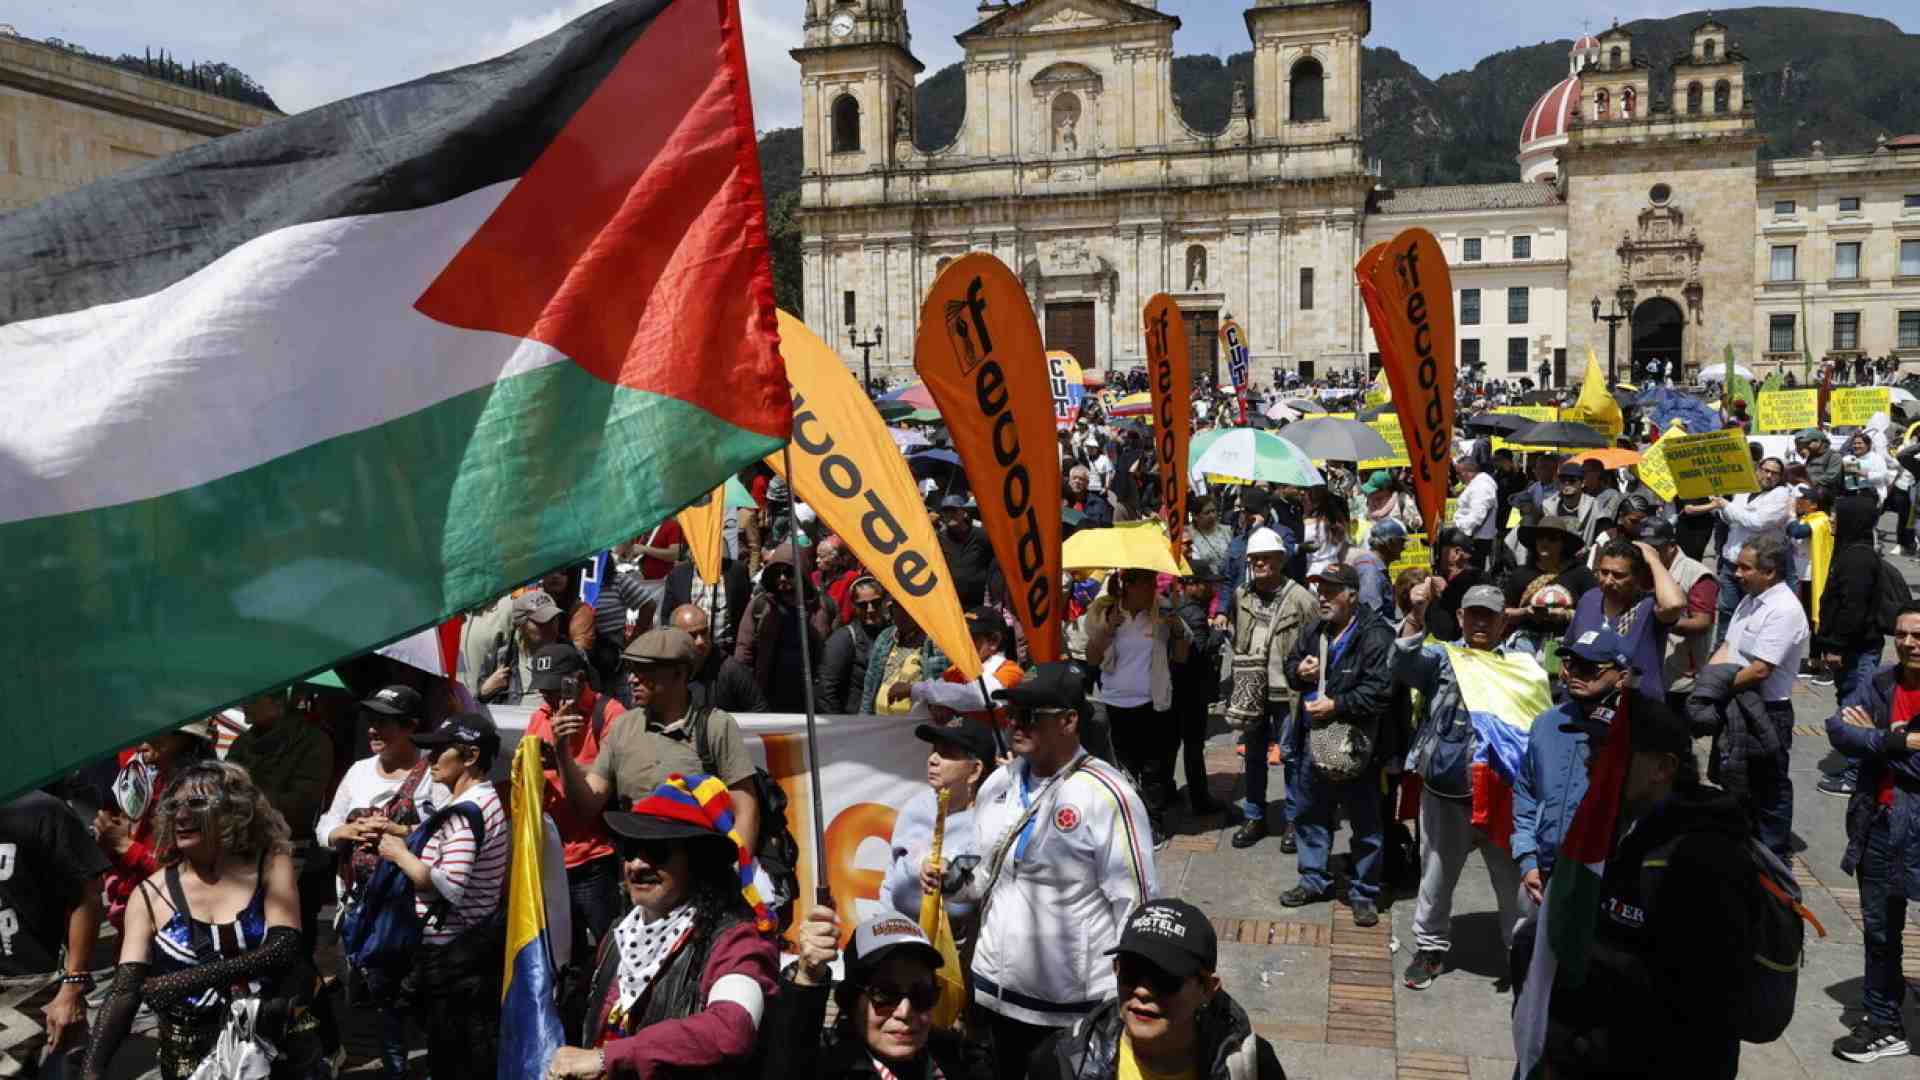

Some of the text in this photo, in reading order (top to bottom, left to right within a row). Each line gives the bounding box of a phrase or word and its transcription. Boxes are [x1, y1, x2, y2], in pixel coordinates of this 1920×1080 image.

[967, 275, 1051, 628] fecode
[1049, 359, 1070, 417] CUT
[1227, 327, 1246, 385] CUT
[1401, 241, 1447, 463] fecode
[792, 392, 938, 597] code
